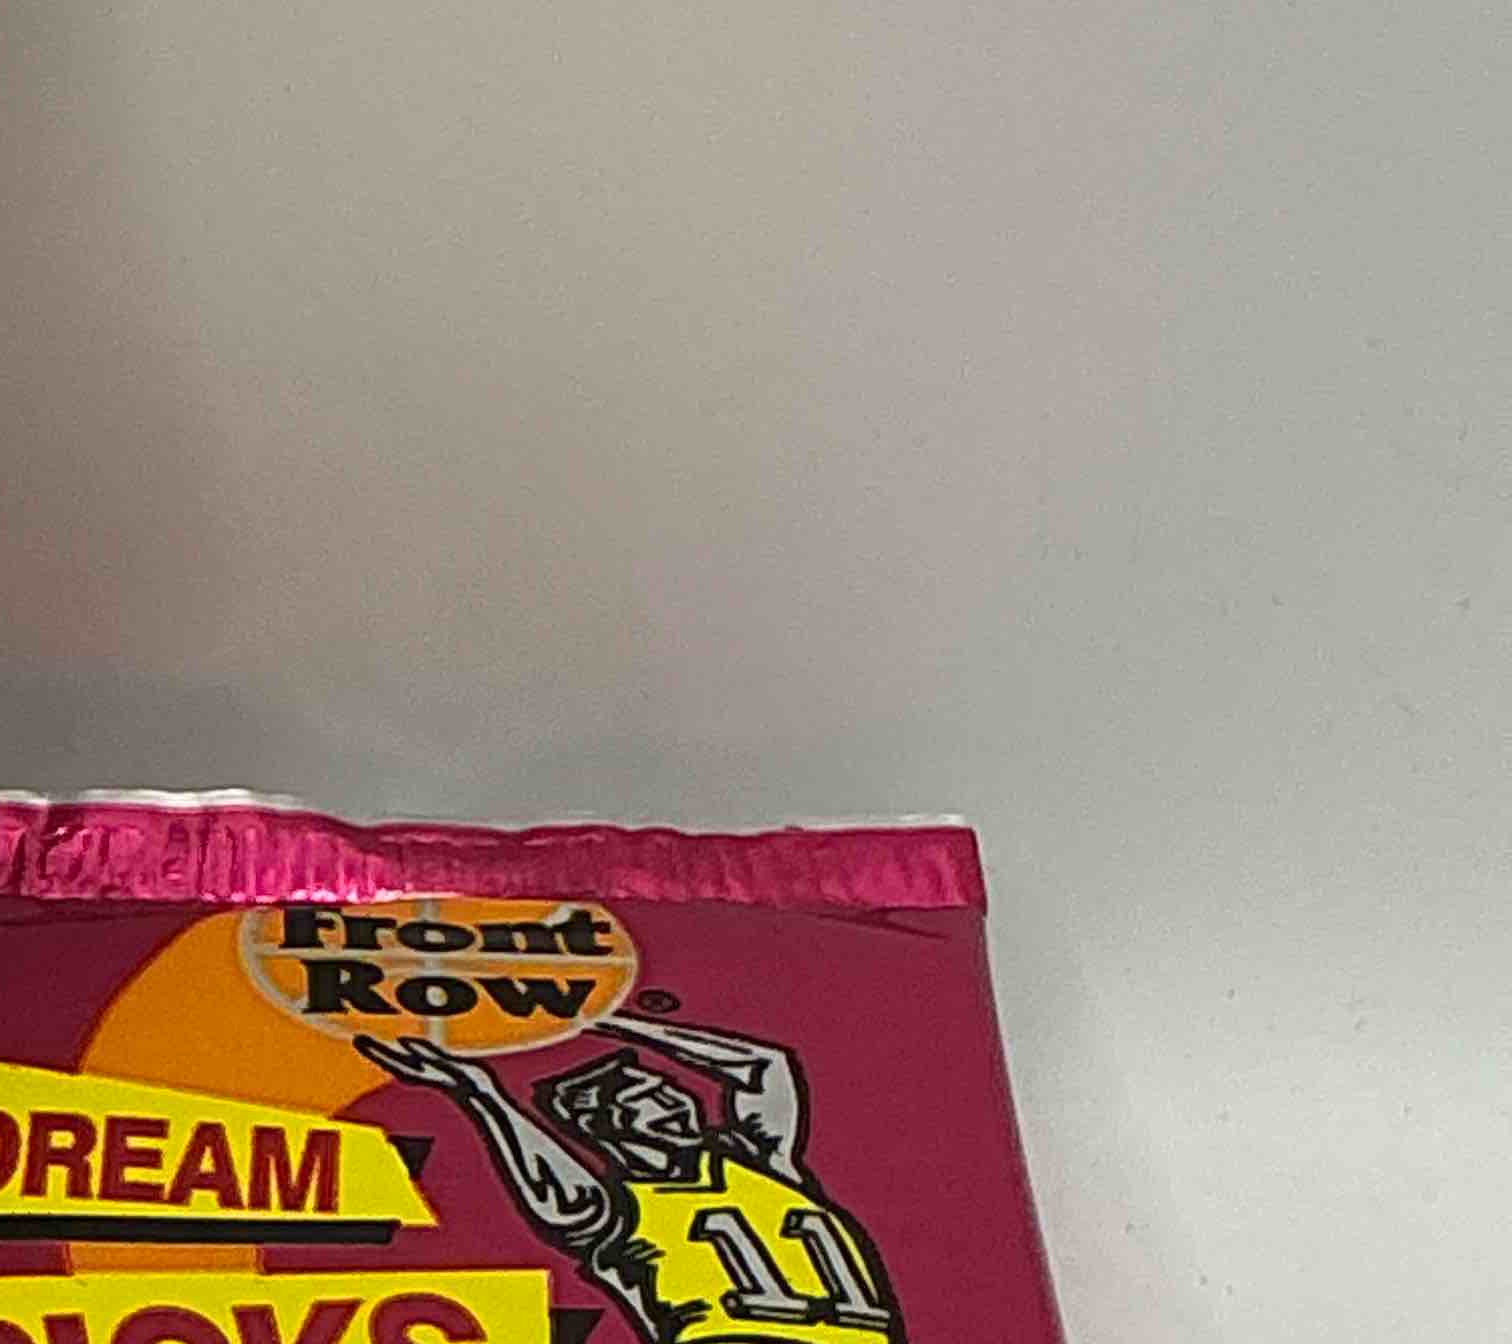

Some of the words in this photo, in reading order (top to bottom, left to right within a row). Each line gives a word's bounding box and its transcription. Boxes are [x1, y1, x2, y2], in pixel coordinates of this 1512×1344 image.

[279, 906, 613, 955] Front
[303, 959, 596, 1017] Row
[690, 1209, 887, 1327] 11
